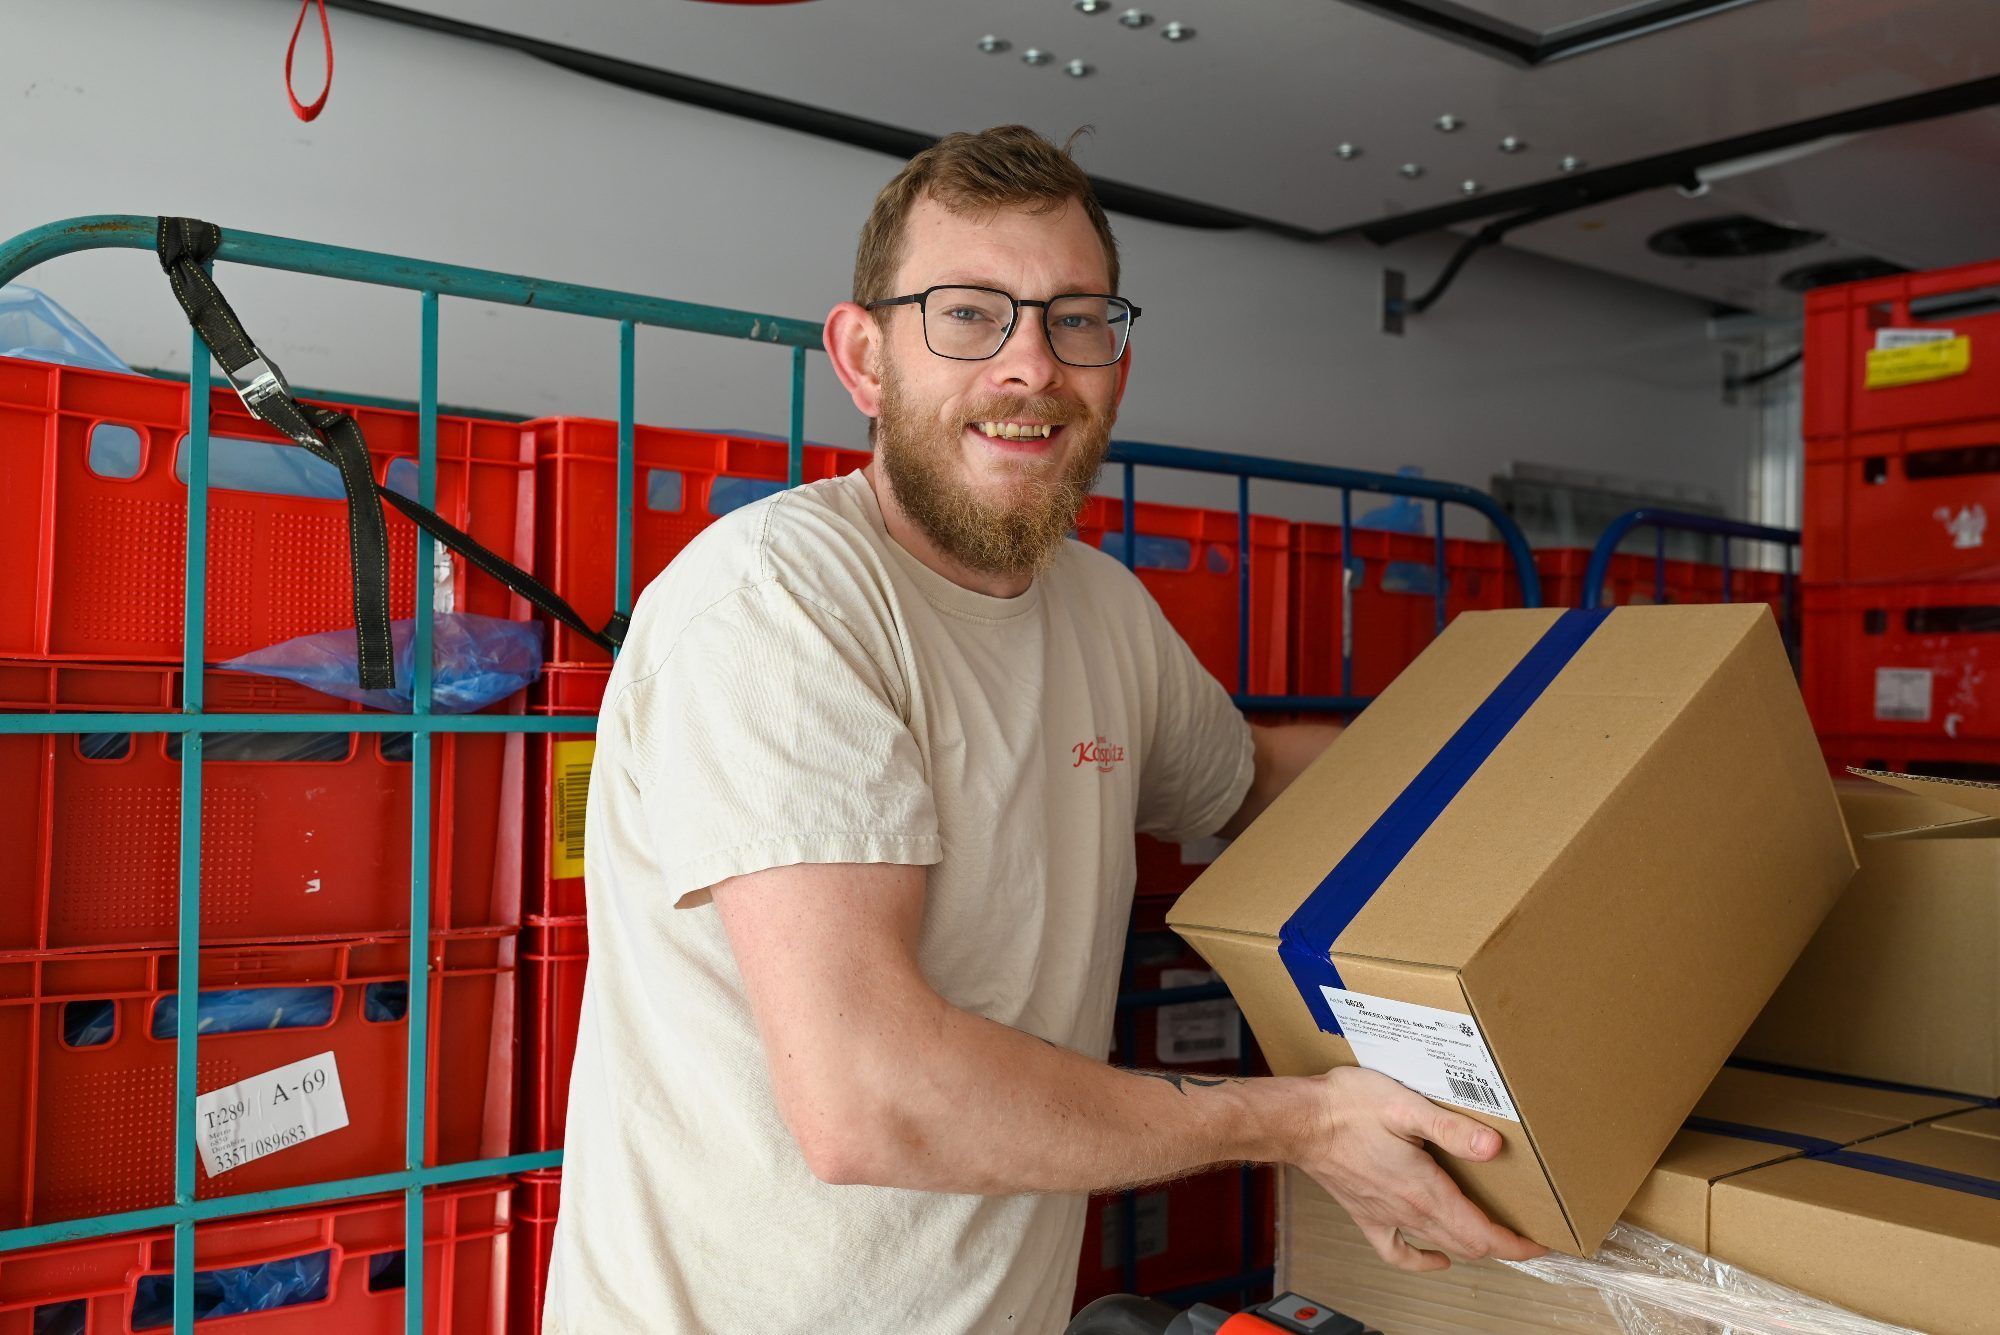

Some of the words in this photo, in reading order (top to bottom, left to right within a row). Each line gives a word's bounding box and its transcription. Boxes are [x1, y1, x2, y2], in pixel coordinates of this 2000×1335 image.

[1344, 999, 1365, 1009] 6628
[1459, 1071, 1475, 1082] 2,5
[1475, 1076, 1489, 1087] kg
[214, 1124, 307, 1173] 3357/089683
